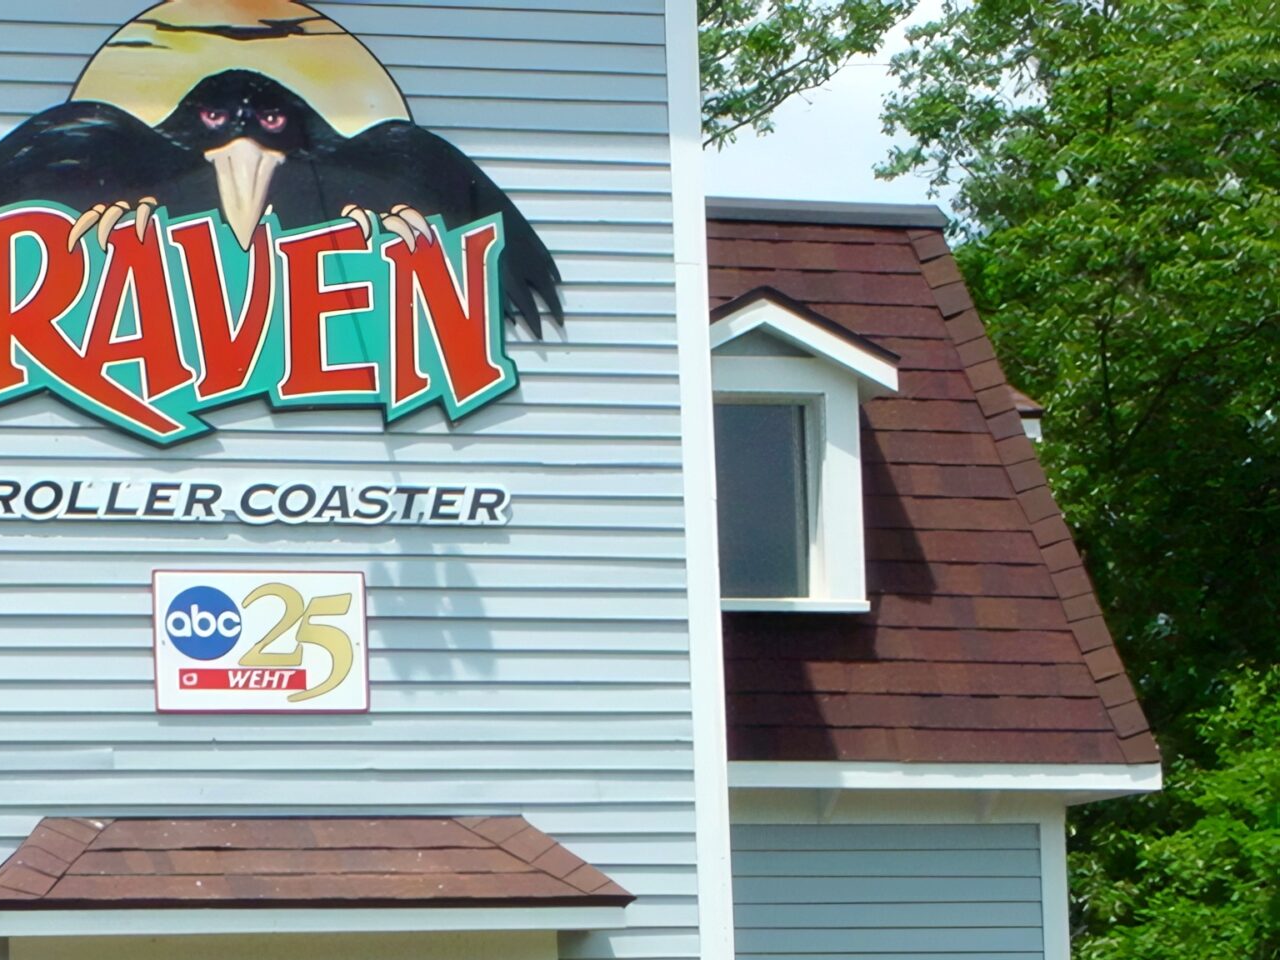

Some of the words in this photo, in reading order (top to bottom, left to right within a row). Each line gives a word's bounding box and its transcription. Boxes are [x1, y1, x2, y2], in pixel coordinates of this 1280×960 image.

[238, 481, 508, 524] COASTER
[166, 603, 242, 638] abc
[238, 581, 354, 703] 25
[227, 669, 297, 690] WEHT
